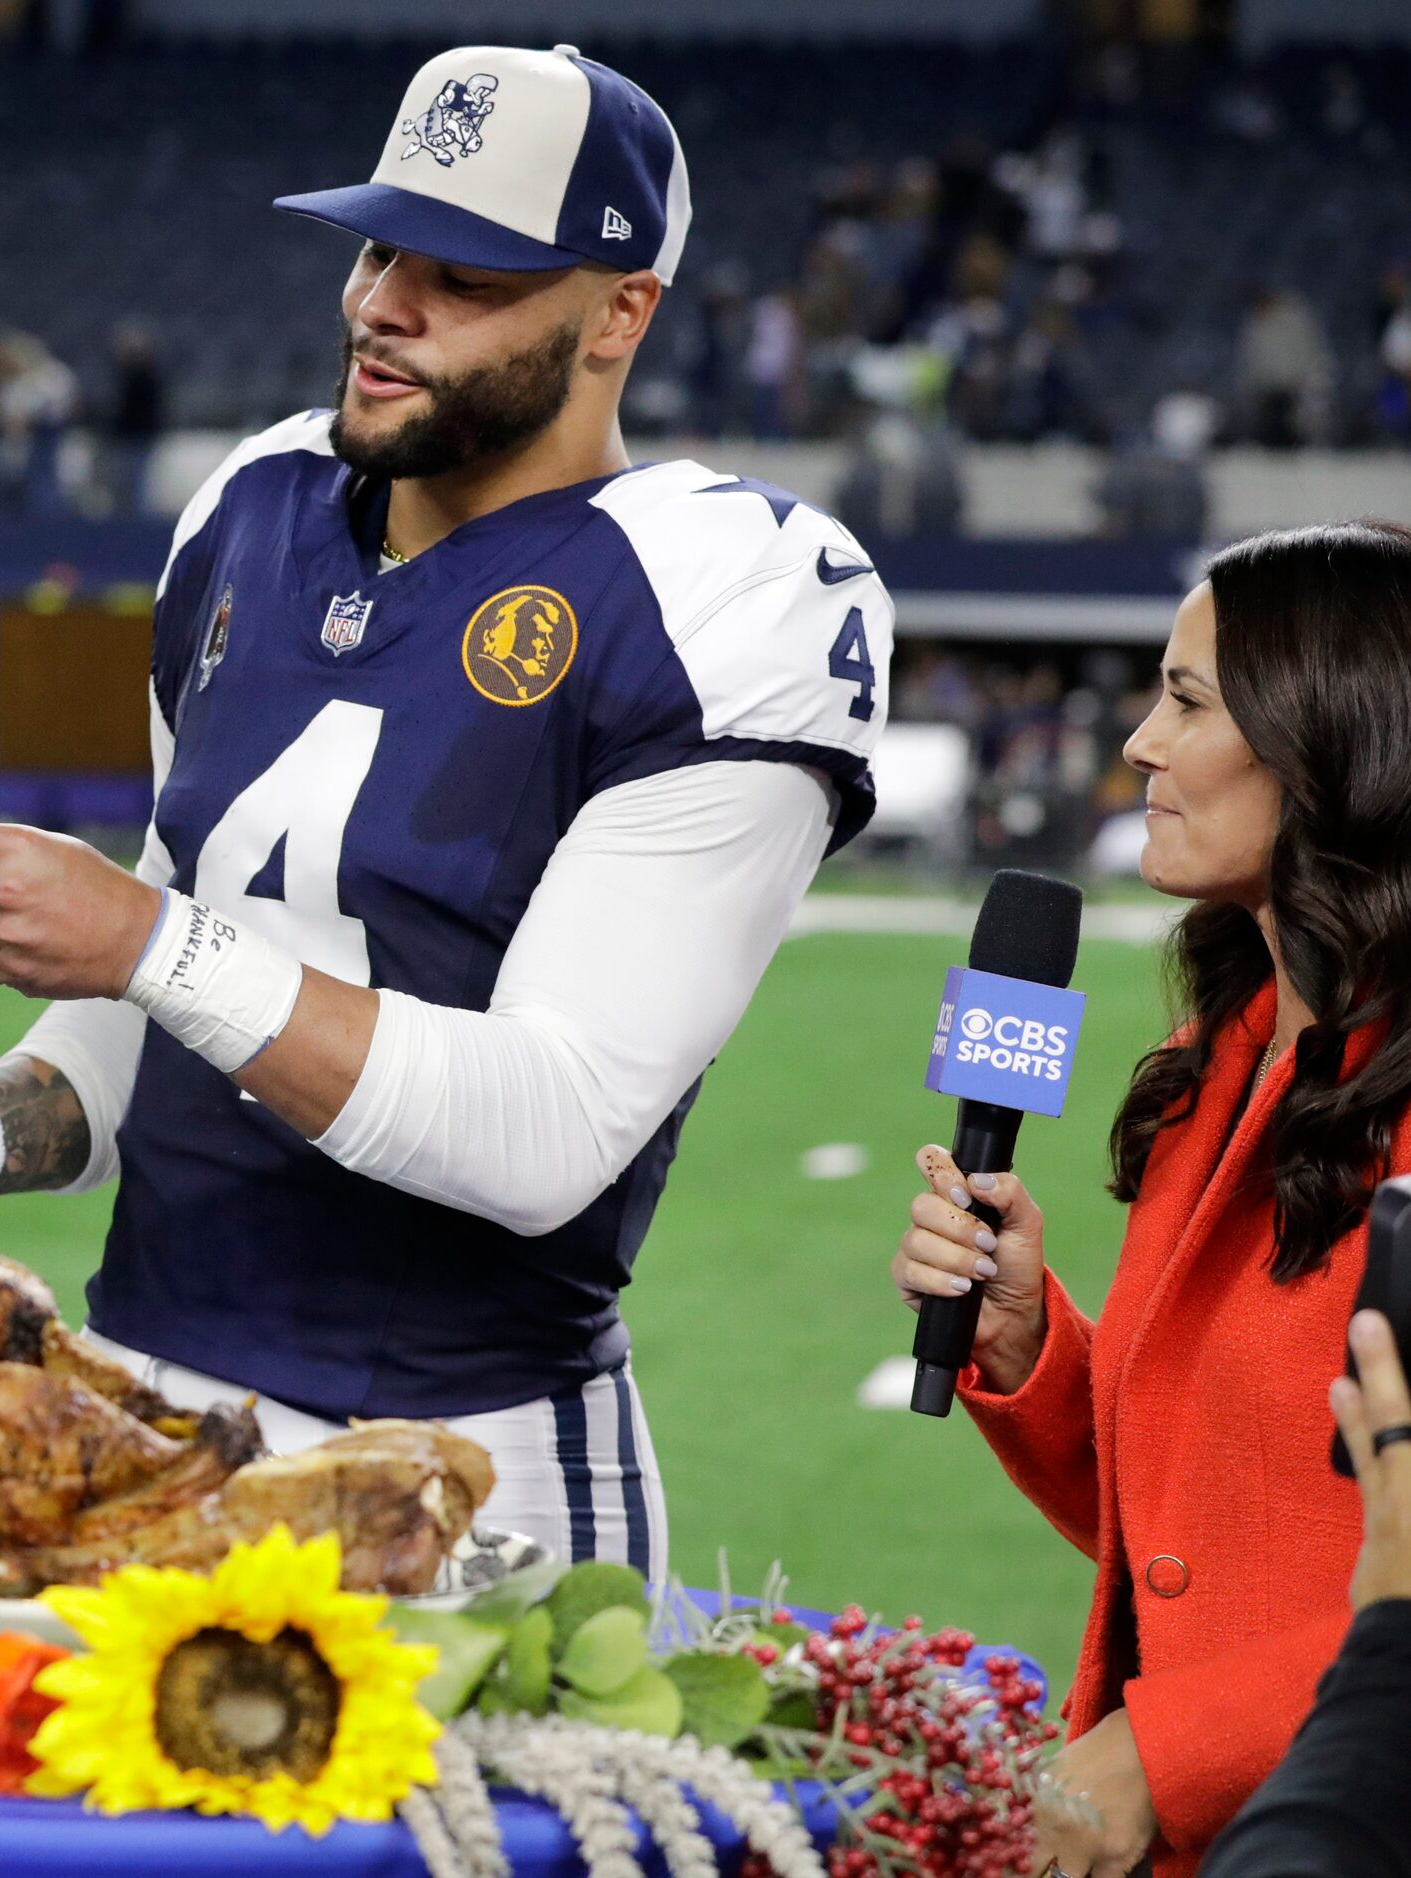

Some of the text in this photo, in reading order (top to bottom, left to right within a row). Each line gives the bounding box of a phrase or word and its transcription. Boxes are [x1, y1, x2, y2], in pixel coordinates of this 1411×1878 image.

[327, 619, 357, 644] NFL
[828, 605, 876, 722] 4
[194, 699, 384, 1102] 4
[213, 918, 237, 952] Be
[993, 1015, 1069, 1057] CBS
[956, 1040, 1063, 1081] SPORTS
